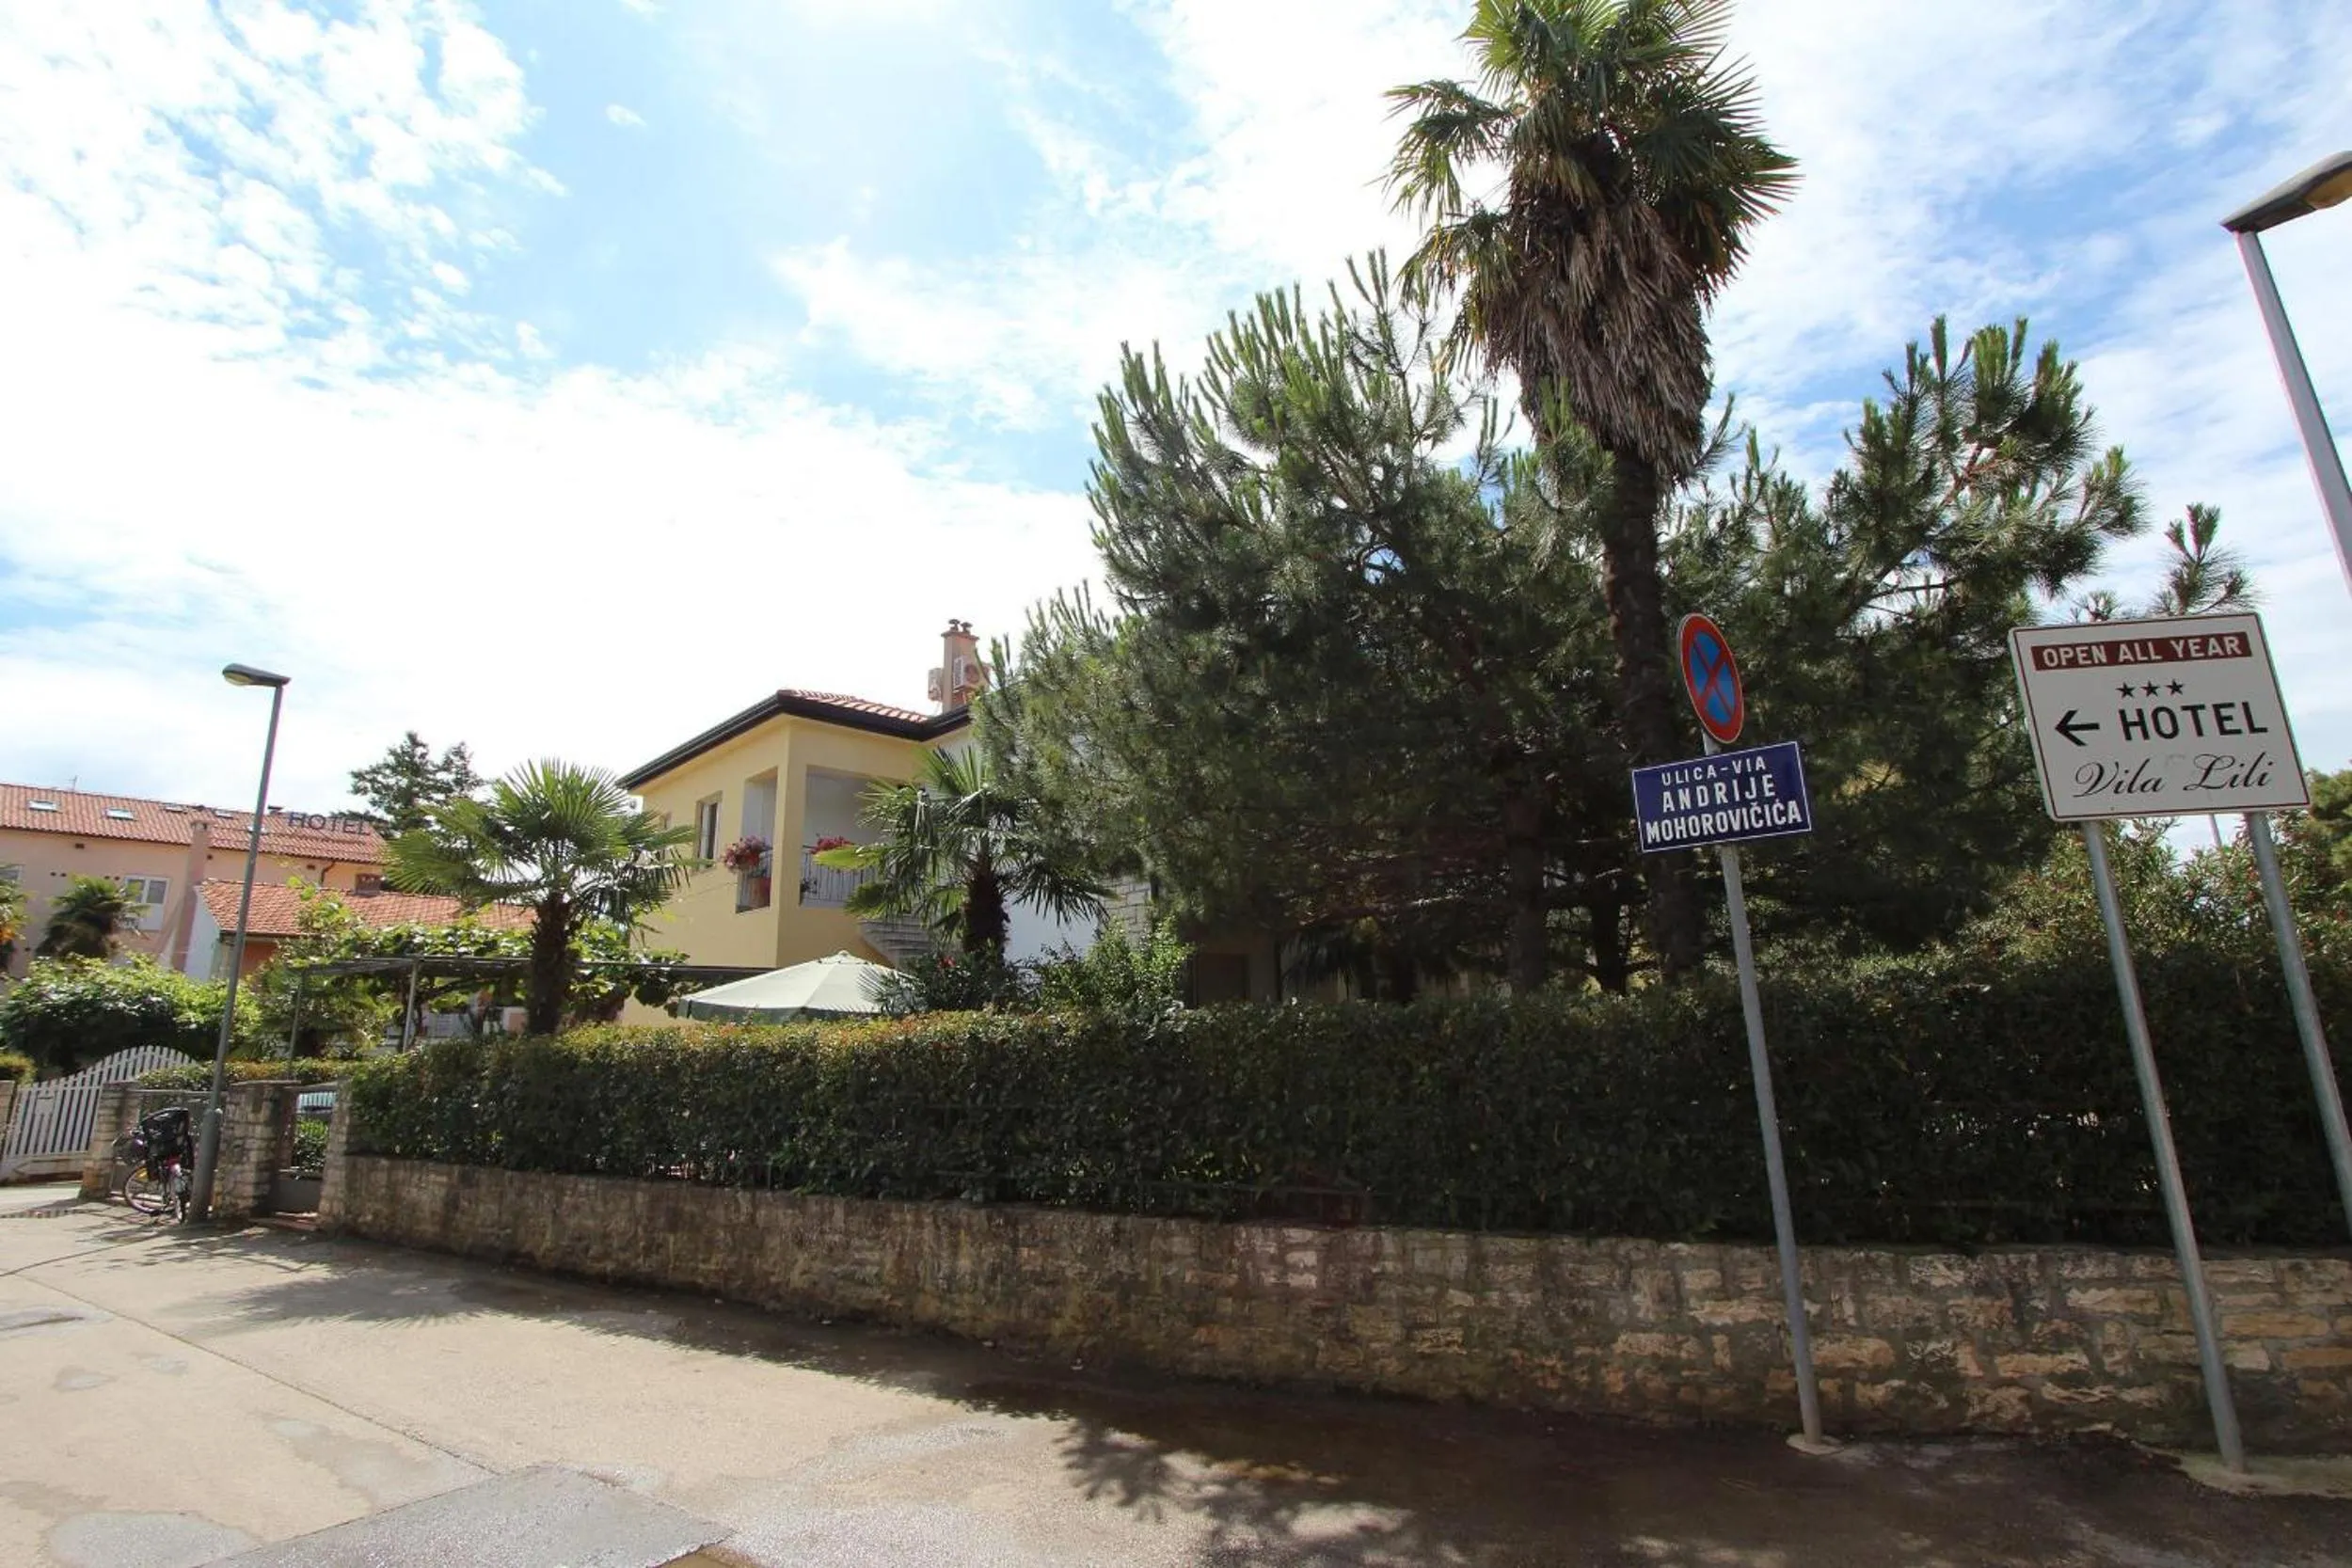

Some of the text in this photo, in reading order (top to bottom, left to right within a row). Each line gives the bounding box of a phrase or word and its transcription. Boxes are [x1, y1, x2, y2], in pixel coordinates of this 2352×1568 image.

[2042, 636, 2244, 668] OPEN ALL YEAR
[2119, 701, 2268, 741] HOTEL
[1661, 755, 1767, 786] ULICA-VIA
[2073, 752, 2276, 798] Vila Lili
[1662, 774, 1776, 813] ANDRIJE
[288, 811, 371, 836] HOTEL
[1646, 799, 1803, 844] MOHOROVIČIĆA
